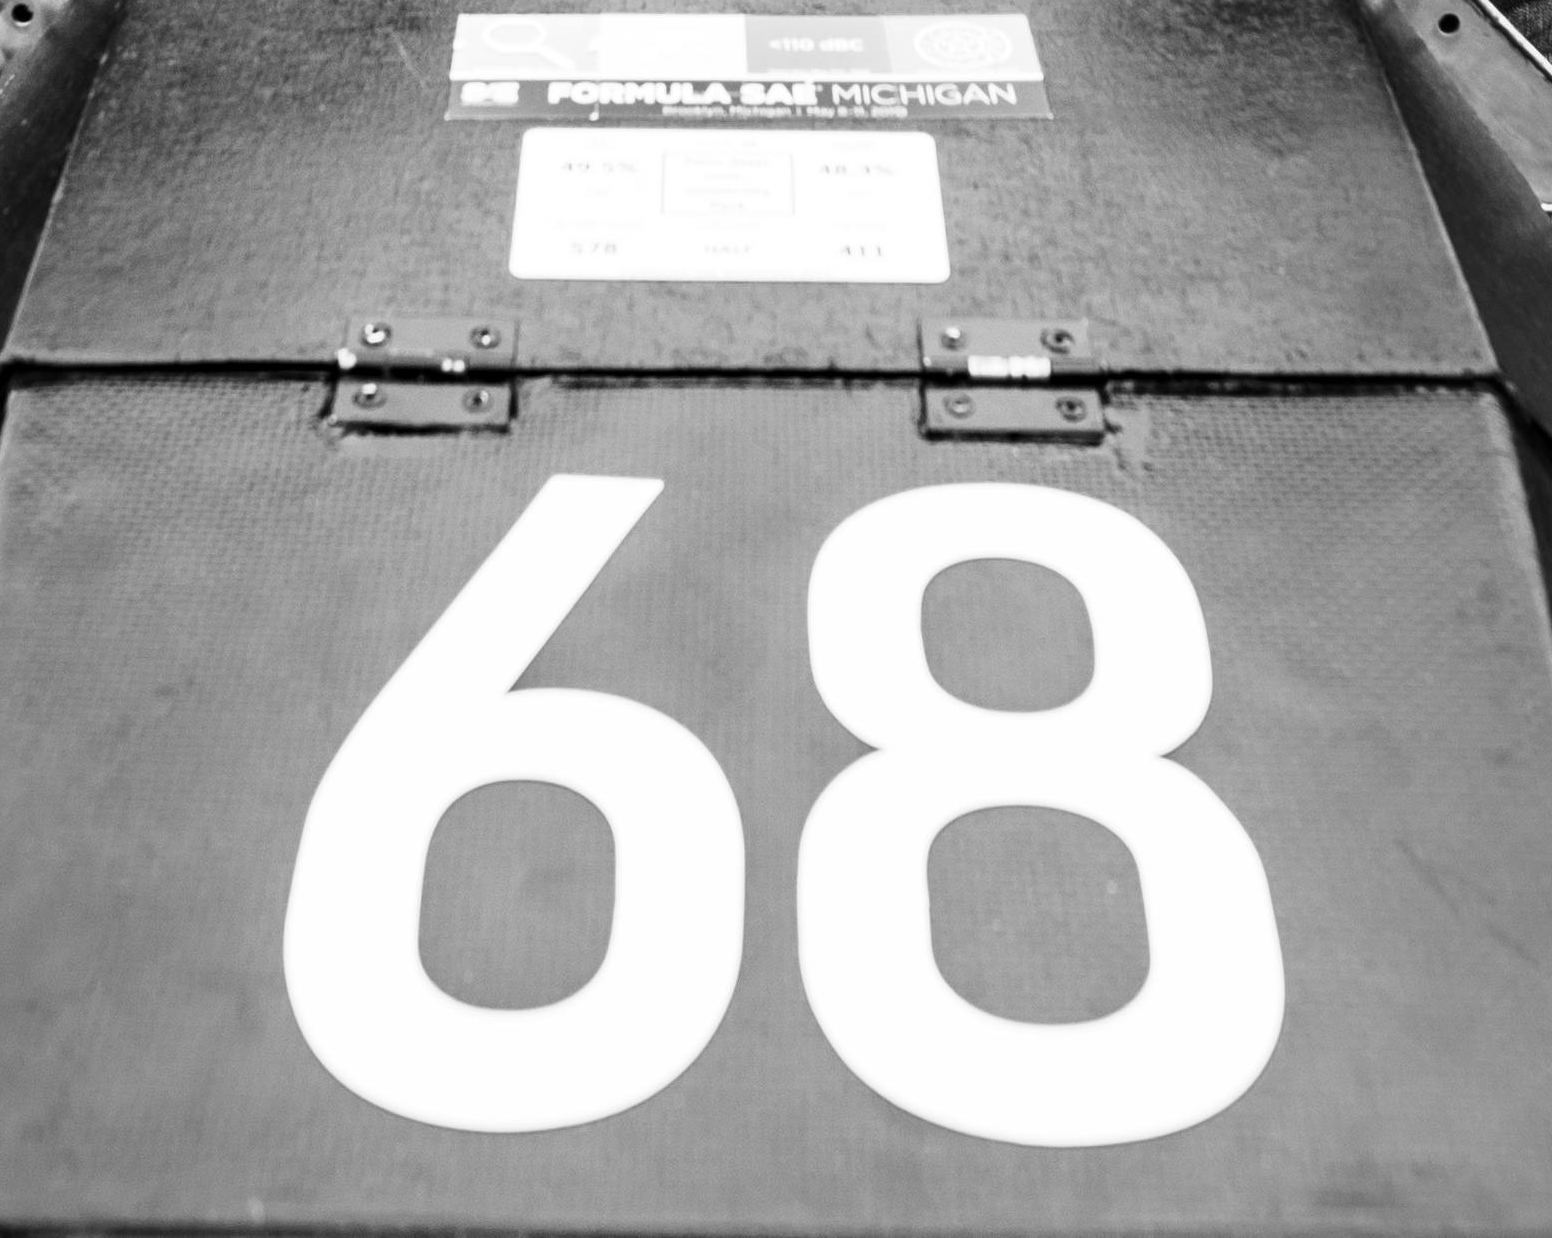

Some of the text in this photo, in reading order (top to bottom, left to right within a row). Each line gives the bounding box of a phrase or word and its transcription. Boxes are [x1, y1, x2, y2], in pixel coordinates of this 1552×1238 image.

[547, 82, 731, 105] FORMULA
[831, 82, 1017, 105] MICHIGAN
[283, 474, 1286, 1148] 68
